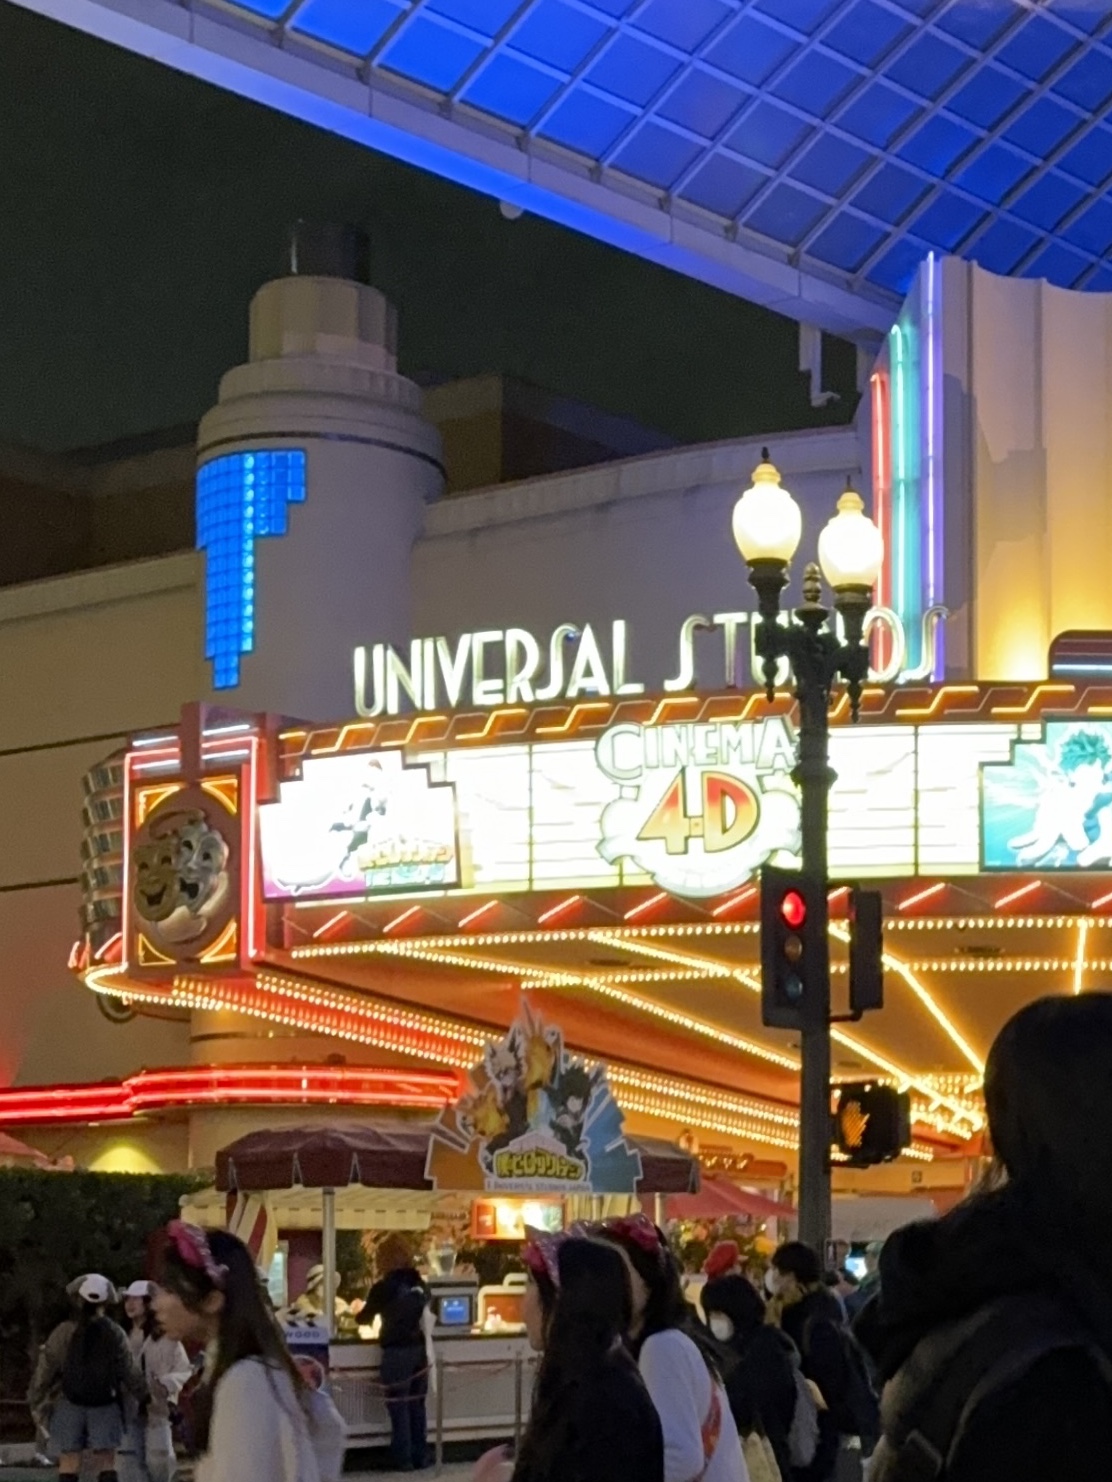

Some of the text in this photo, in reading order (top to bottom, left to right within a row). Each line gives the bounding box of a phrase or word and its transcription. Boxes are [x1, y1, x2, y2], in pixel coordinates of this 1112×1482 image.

[353, 606, 949, 718] UNIVERSAL STUIOS
[594, 715, 798, 781] CINEMA
